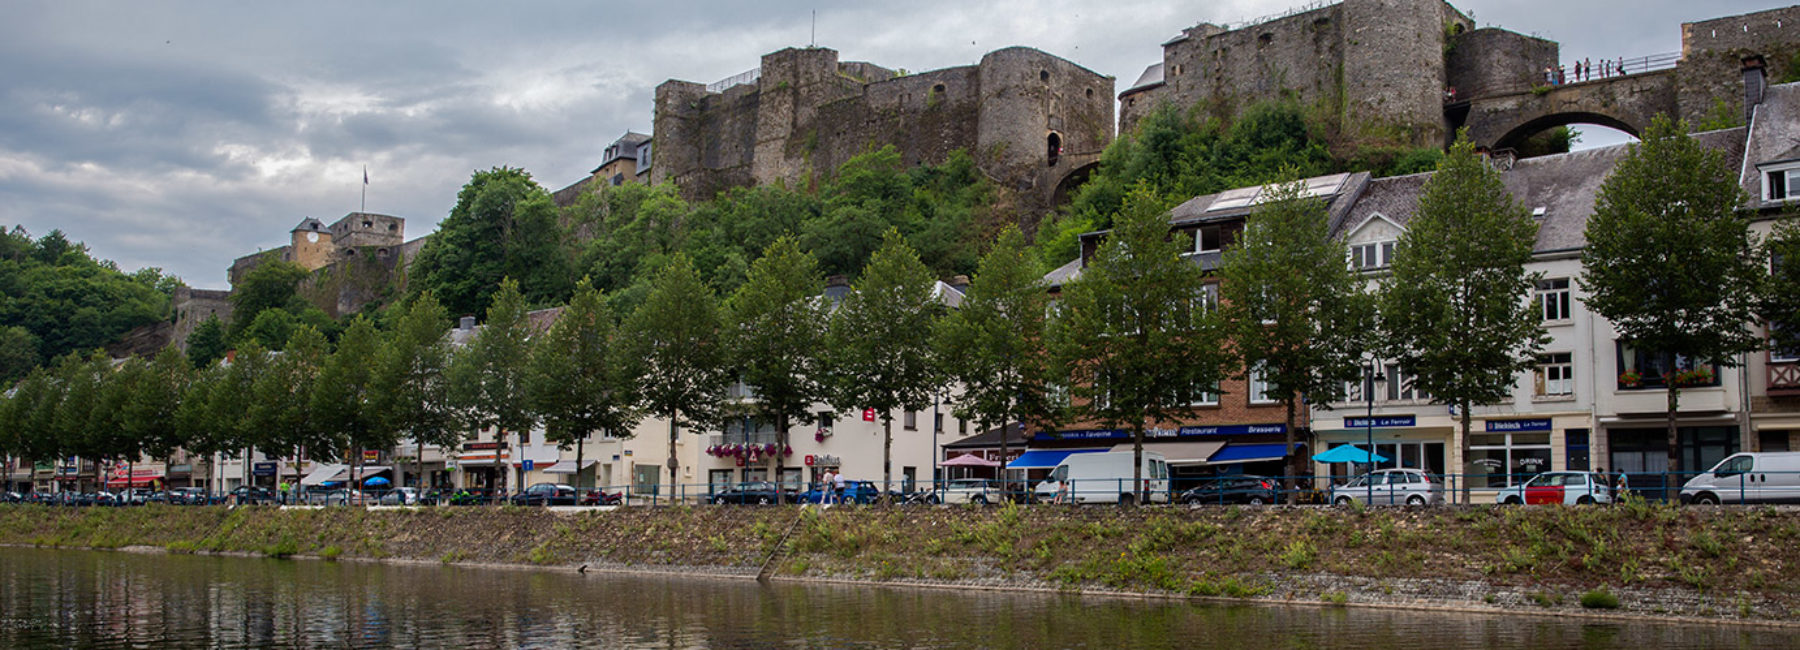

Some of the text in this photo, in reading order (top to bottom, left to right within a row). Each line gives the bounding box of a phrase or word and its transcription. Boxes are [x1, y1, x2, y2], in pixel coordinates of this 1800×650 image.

[1181, 426, 1218, 436] Restaurant
[1248, 425, 1281, 433] Brasserie
[1520, 458, 1543, 466] DRINK
